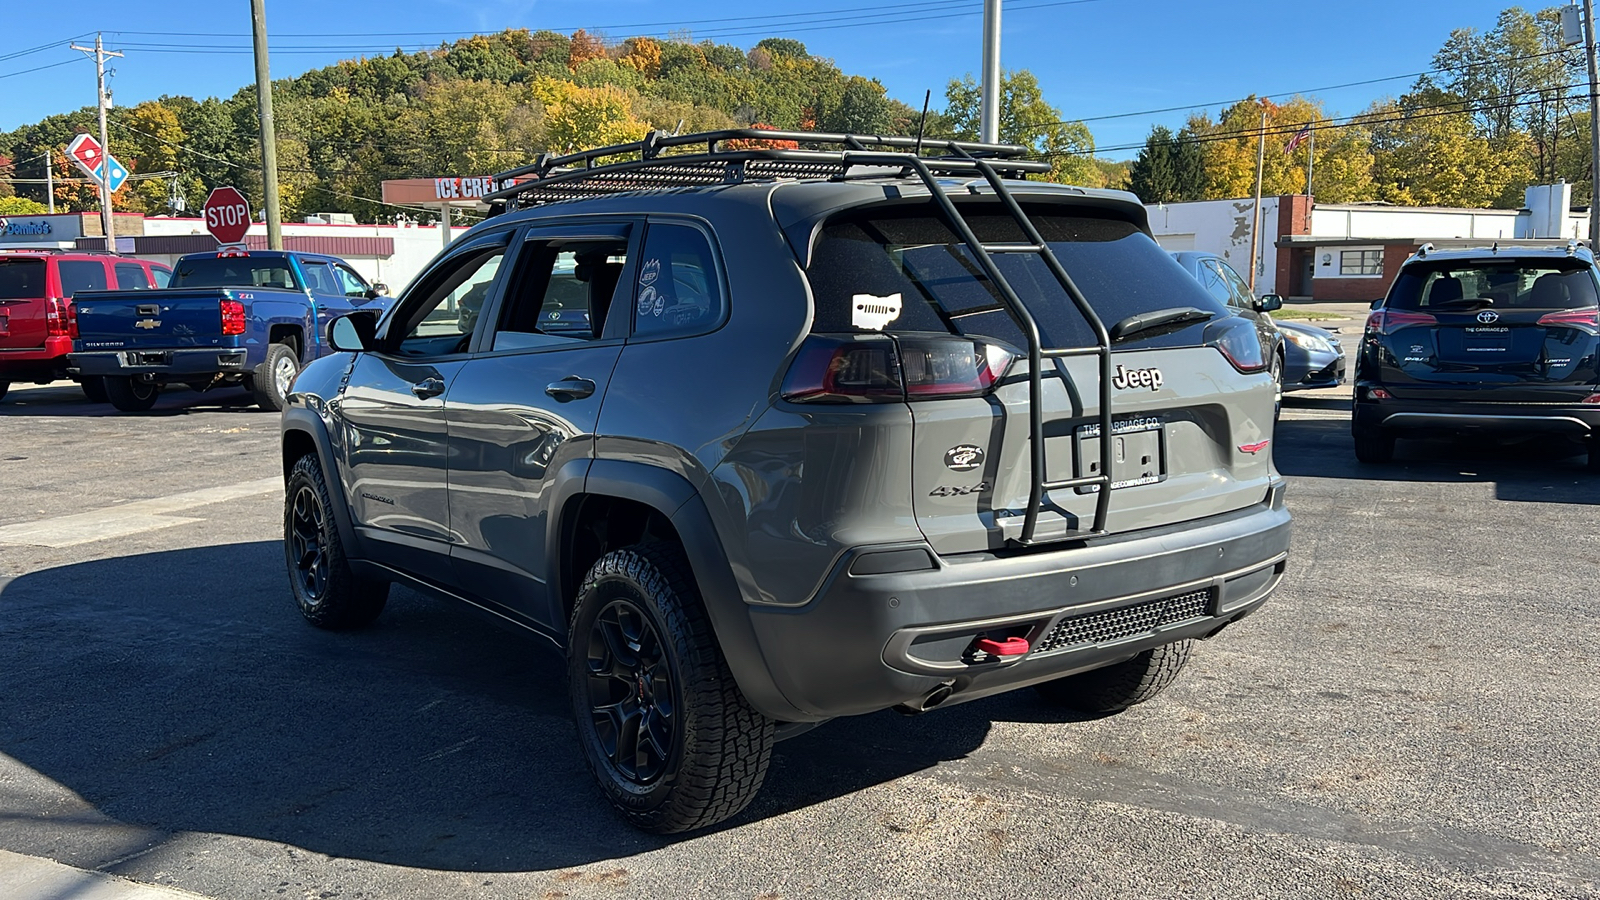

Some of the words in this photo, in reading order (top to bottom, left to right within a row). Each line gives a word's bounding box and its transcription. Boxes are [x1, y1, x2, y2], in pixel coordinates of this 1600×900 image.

[434, 178, 460, 198] ICE
[208, 204, 246, 227] STOP
[8, 221, 52, 235] Domino's
[1112, 364, 1164, 391] Jeep
[1083, 423, 1101, 435] THE
